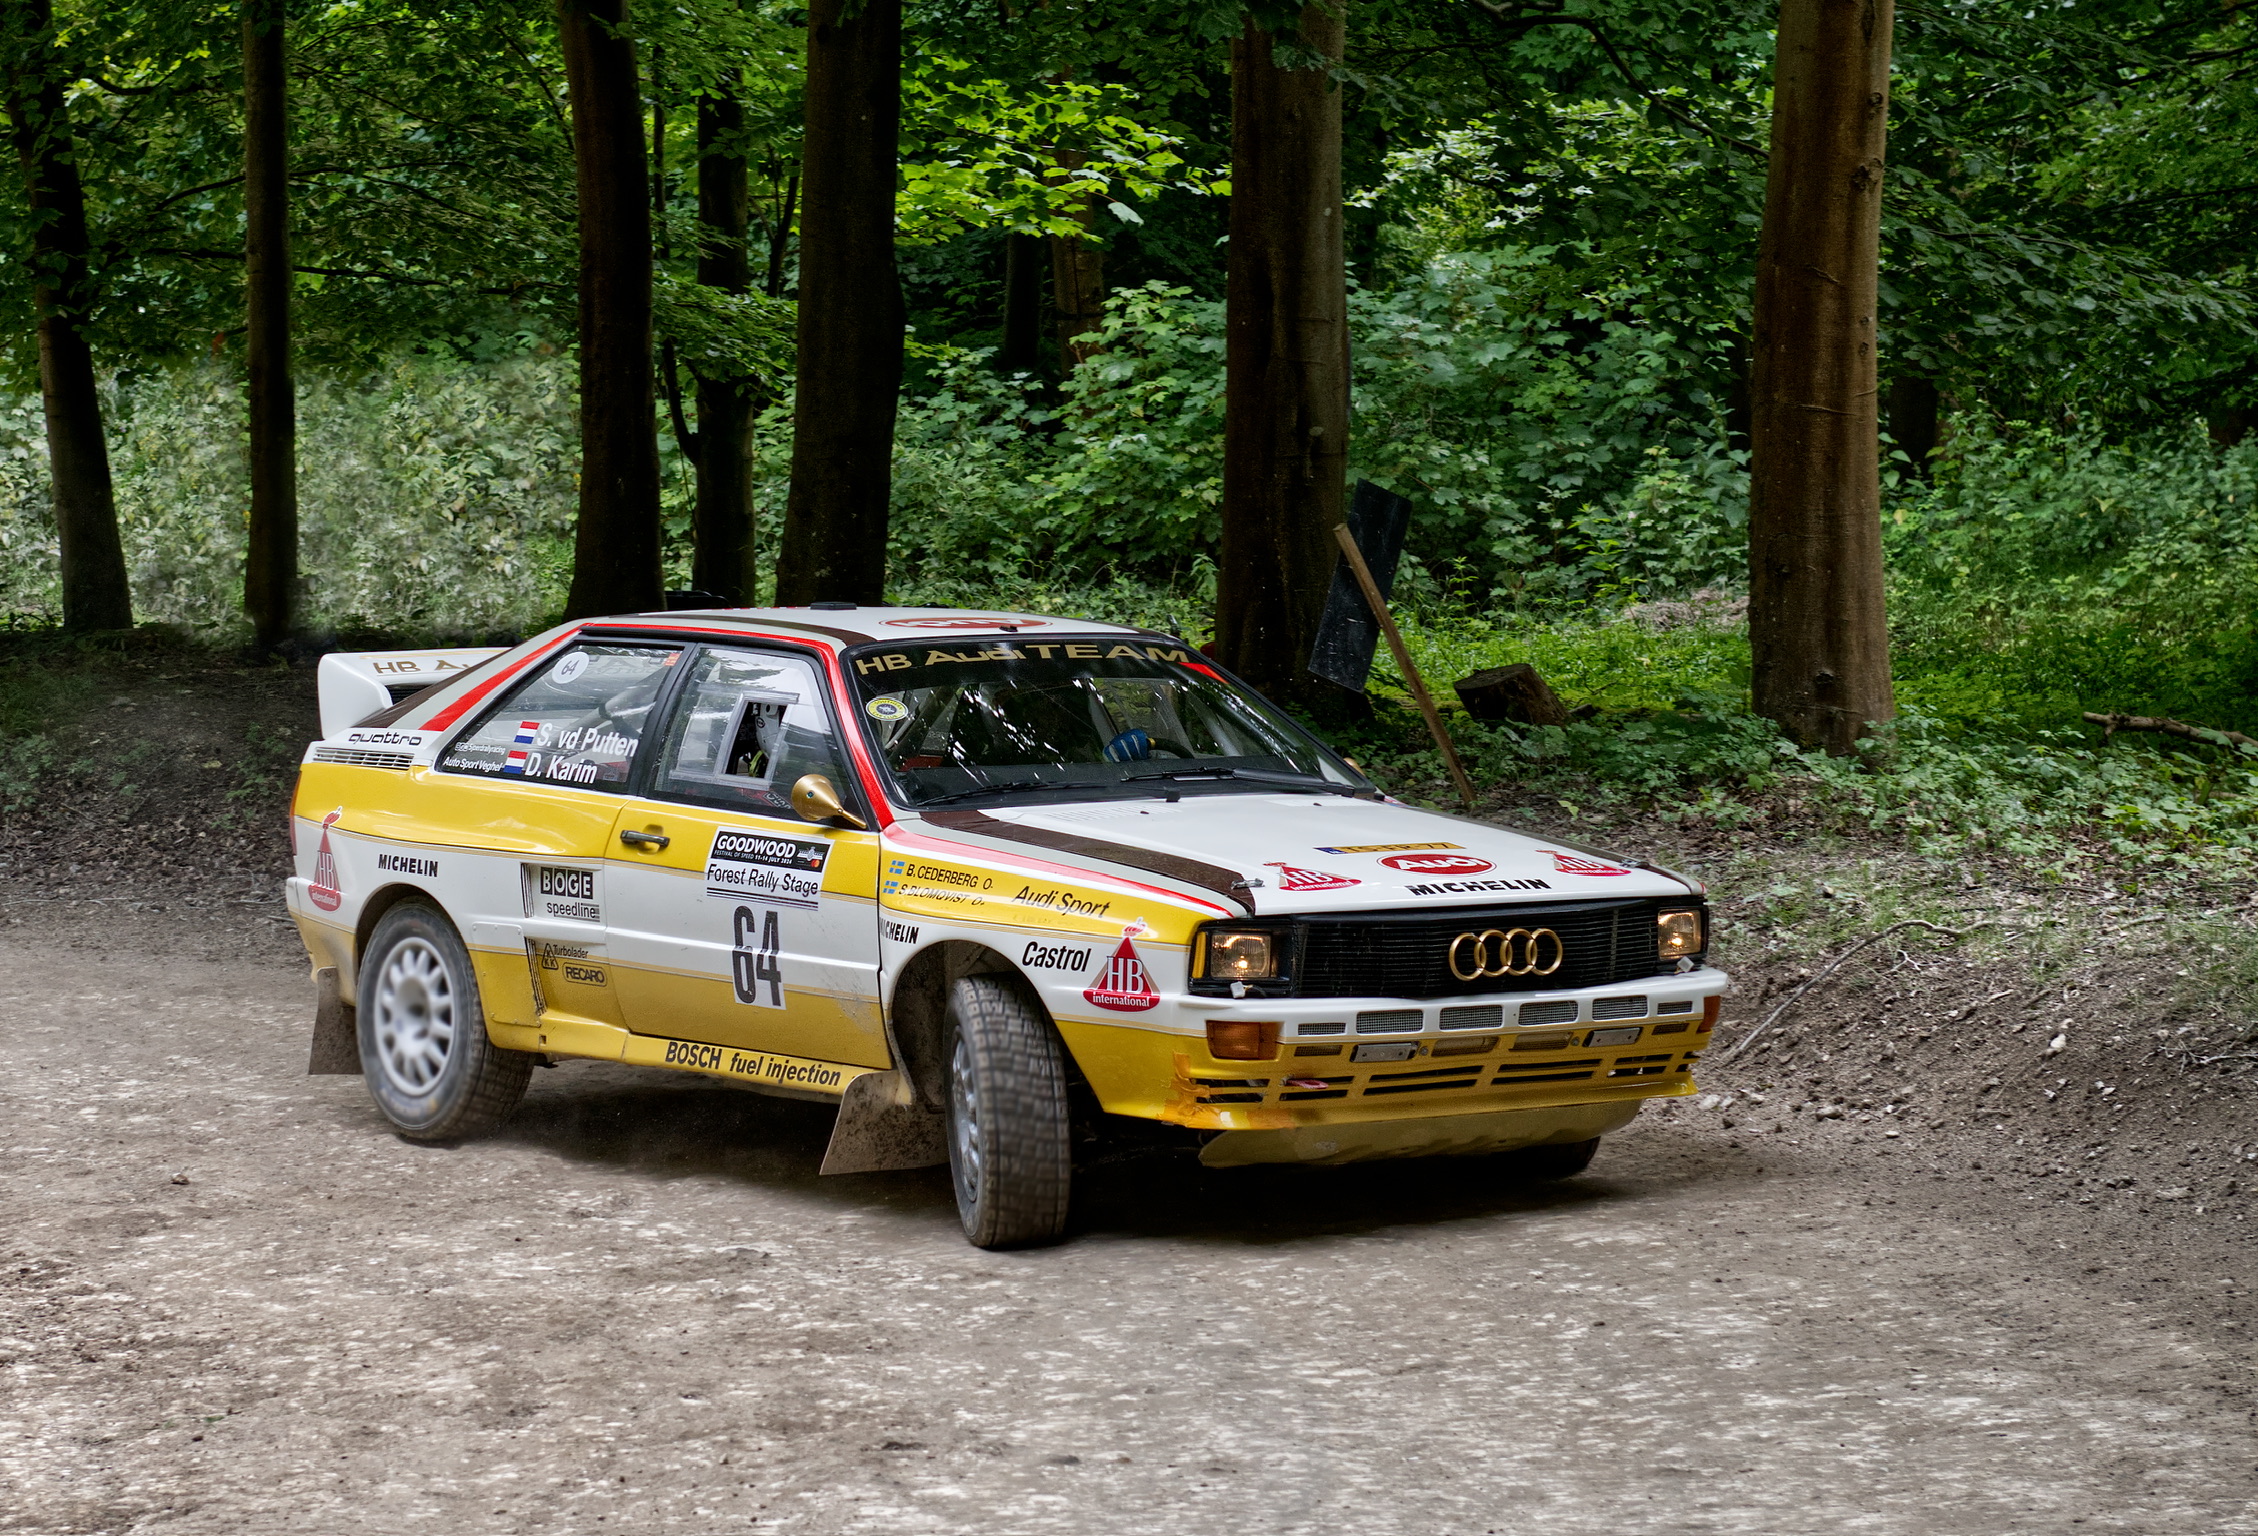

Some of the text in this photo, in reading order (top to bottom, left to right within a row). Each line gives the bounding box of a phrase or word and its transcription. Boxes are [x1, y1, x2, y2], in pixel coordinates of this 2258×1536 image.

[373, 661, 421, 674] HB
[561, 660, 580, 676] 64
[855, 654, 912, 675] HB
[1025, 645, 1190, 664] TEAM
[349, 731, 423, 746] quattro
[537, 723, 639, 758] S. vd Putten
[443, 756, 461, 767] Auto
[460, 758, 479, 770] Sport
[525, 753, 598, 783] D. Karim
[717, 835, 797, 858] GOODWOOD
[378, 854, 438, 877] MICHELIN
[714, 850, 733, 858] FESTIVAL
[768, 856, 781, 864] JULY
[1553, 858, 1605, 869] HB
[317, 850, 335, 890] HB
[1277, 870, 1333, 885] HB
[541, 868, 593, 898] BOGE
[707, 864, 818, 897] Forest Rally Stage
[1290, 881, 1354, 891] international
[1405, 878, 1552, 896] MICHELIN
[546, 901, 597, 919] speedline
[1013, 885, 1110, 918] Audi Sport
[553, 944, 588, 959] Turbolader
[732, 906, 782, 1007] 64
[1022, 941, 1092, 972] Castrol
[565, 966, 605, 984] RECARO
[1106, 955, 1144, 994] HB
[1092, 992, 1150, 1007] international
[665, 1041, 841, 1086] BOSCH fuel injection
